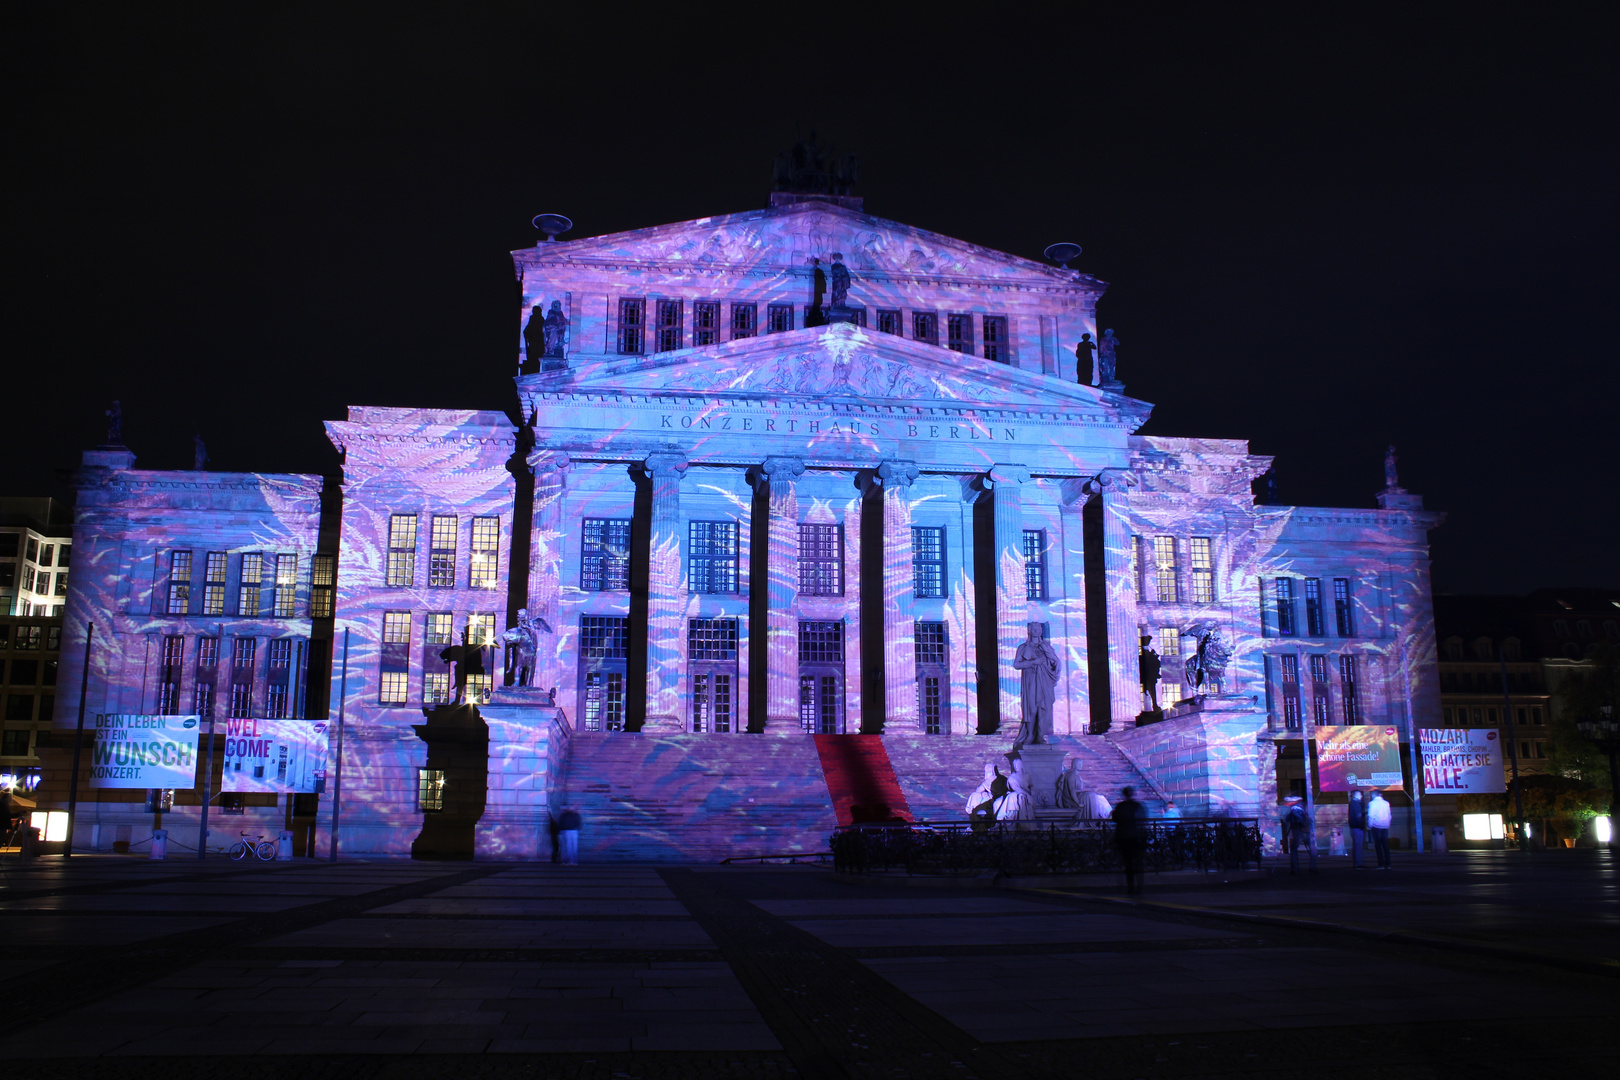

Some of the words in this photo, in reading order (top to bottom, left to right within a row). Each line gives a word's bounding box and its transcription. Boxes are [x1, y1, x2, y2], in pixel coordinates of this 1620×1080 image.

[660, 414, 880, 435] KONZERTHAUS
[908, 423, 1016, 441] BERLIN
[96, 714, 124, 728] DEIN
[128, 715, 166, 729] LEBEN
[226, 718, 261, 737] WEL
[112, 729, 128, 740] EIN
[1419, 729, 1473, 745] MOZART,
[225, 738, 273, 758] COME
[1317, 739, 1339, 750] Mehr
[1340, 740, 1350, 750] als
[1351, 740, 1369, 750] eine
[93, 741, 193, 766] WUNSCH
[1318, 750, 1345, 762] schöne
[1346, 750, 1380, 762] Fassade!
[1441, 754, 1473, 766] HATTE
[1475, 754, 1491, 766] SIE
[89, 766, 142, 779] KONZERT.
[1425, 768, 1468, 789] ALLE.
